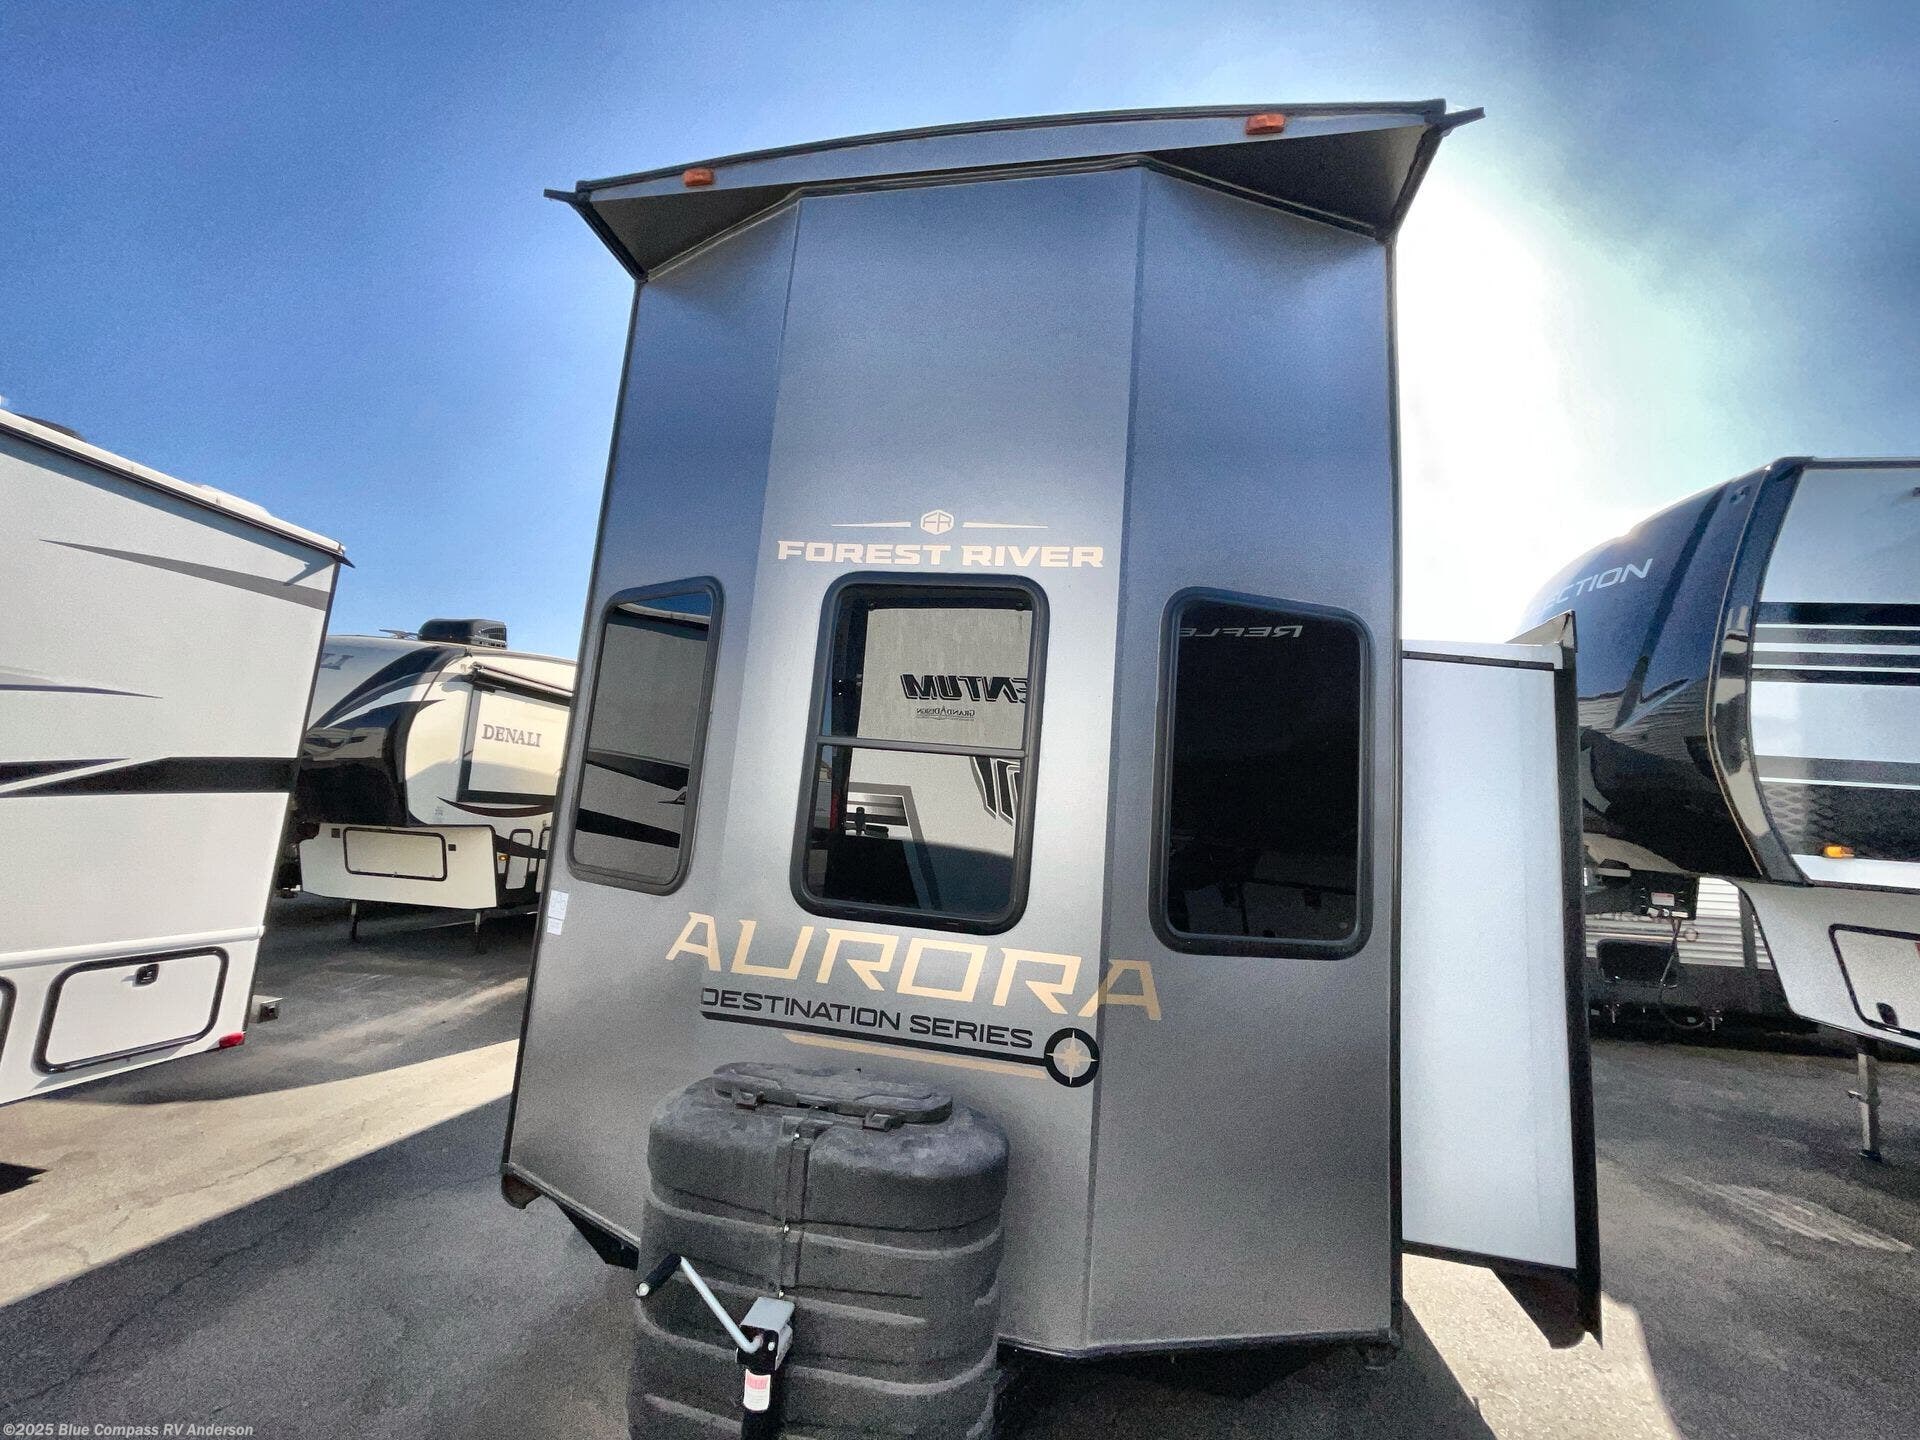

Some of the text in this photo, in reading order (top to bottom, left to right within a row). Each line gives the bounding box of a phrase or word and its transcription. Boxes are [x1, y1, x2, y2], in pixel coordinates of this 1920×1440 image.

[777, 540, 1104, 567] FOREST RIVER
[481, 724, 542, 747] DENALI
[665, 912, 1162, 1021] AURORA
[701, 988, 1033, 1049] DESTINATION SERIES
